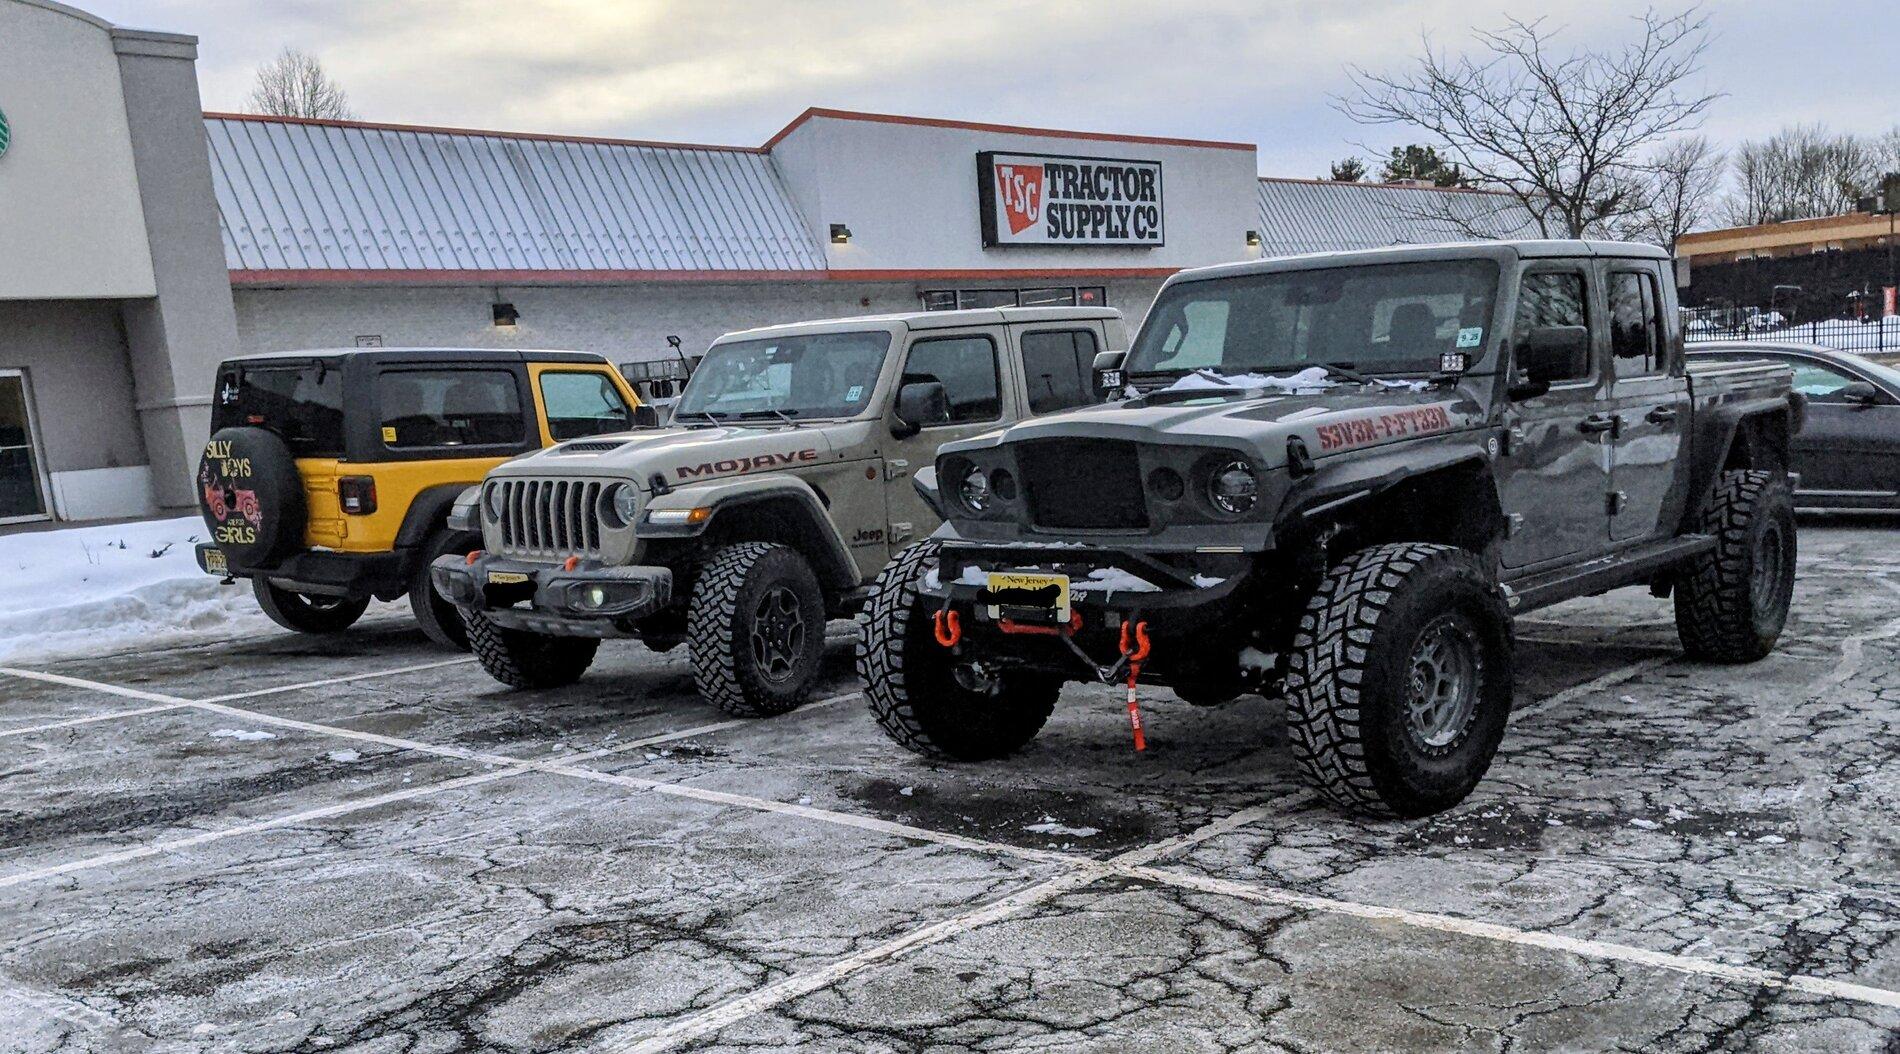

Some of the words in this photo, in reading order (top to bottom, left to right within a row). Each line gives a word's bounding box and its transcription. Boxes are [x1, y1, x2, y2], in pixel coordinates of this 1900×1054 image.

[1002, 167, 1037, 221] TSC
[1045, 163, 1156, 201] TRACTOR
[1046, 203, 1130, 239] SUPPLY
[206, 440, 231, 458] SILLY
[676, 449, 818, 479] MOJAVE
[216, 526, 256, 544] GIRLS
[853, 528, 883, 541] Jeep
[1006, 575, 1024, 584] New
[1024, 576, 1049, 586] Jersey
